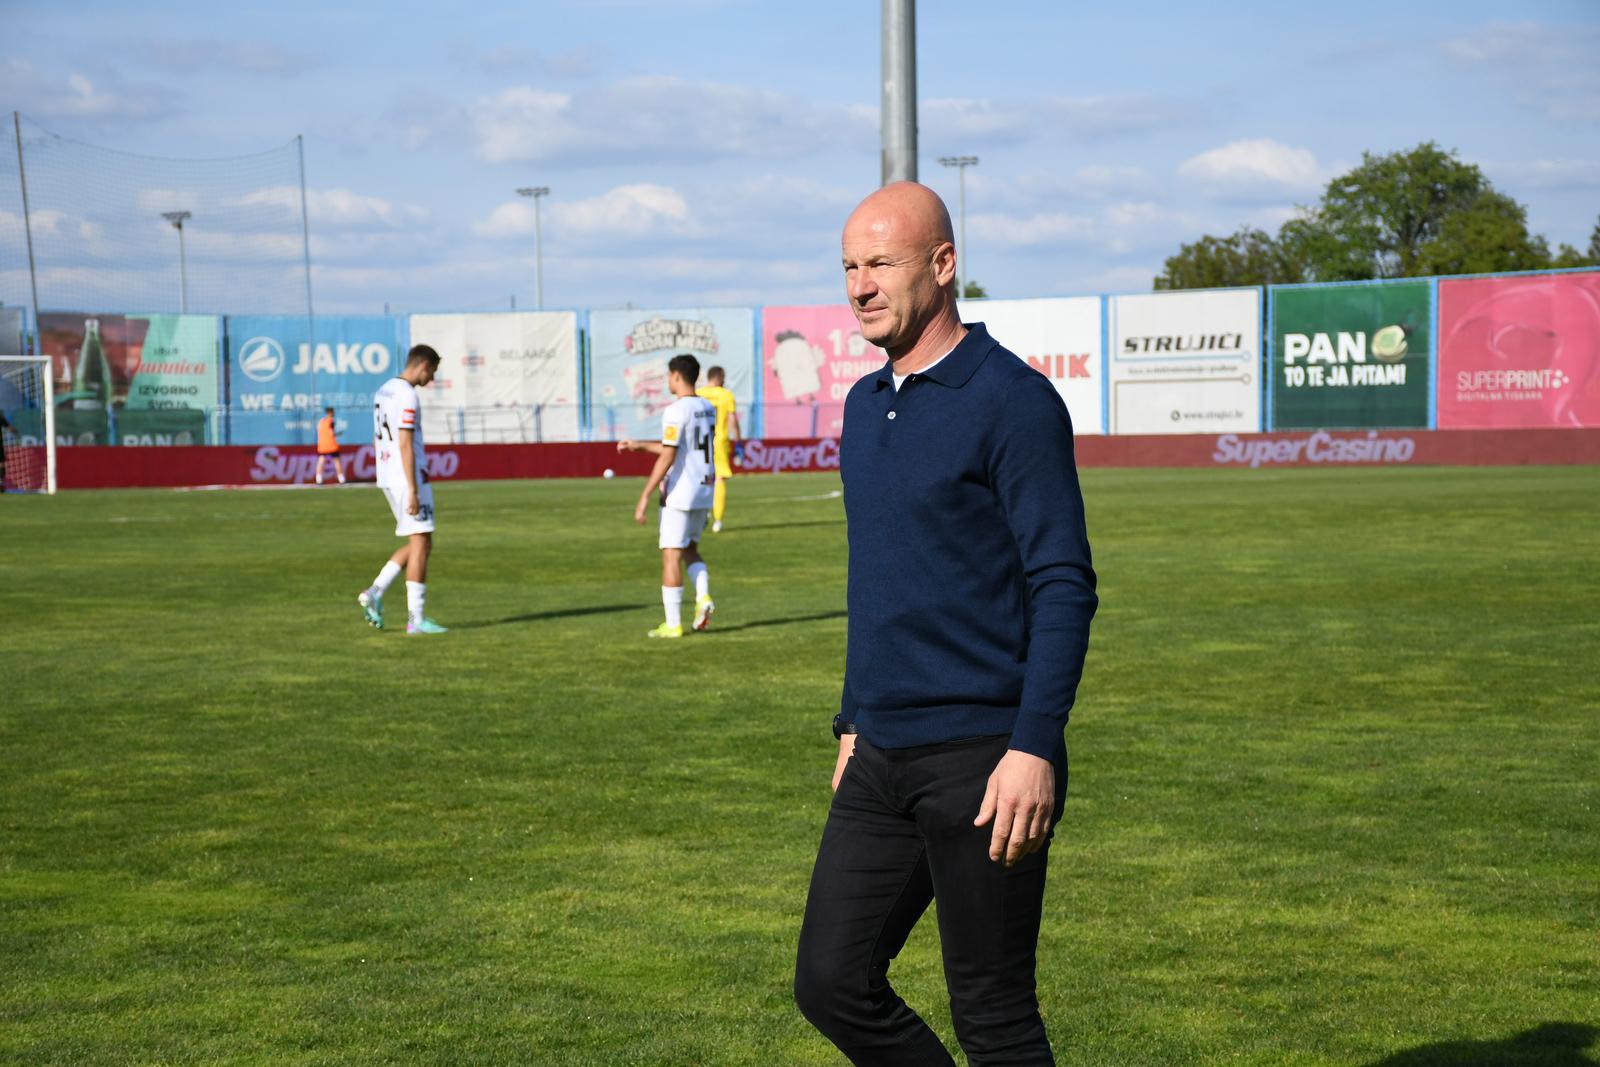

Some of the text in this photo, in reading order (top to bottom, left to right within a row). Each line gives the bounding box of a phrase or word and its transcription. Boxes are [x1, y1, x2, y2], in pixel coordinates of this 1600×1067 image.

[292, 343, 391, 374] JAKO
[1284, 331, 1366, 364] PAN
[1284, 363, 1406, 388] TO TE JA PITAM!
[1457, 369, 1552, 391] SUPERPRINT
[138, 385, 198, 395] IZVORNO
[240, 394, 275, 410] WE
[281, 394, 322, 409] ARE
[123, 434, 172, 446] PAN
[1212, 430, 1415, 468] SuperCasino
